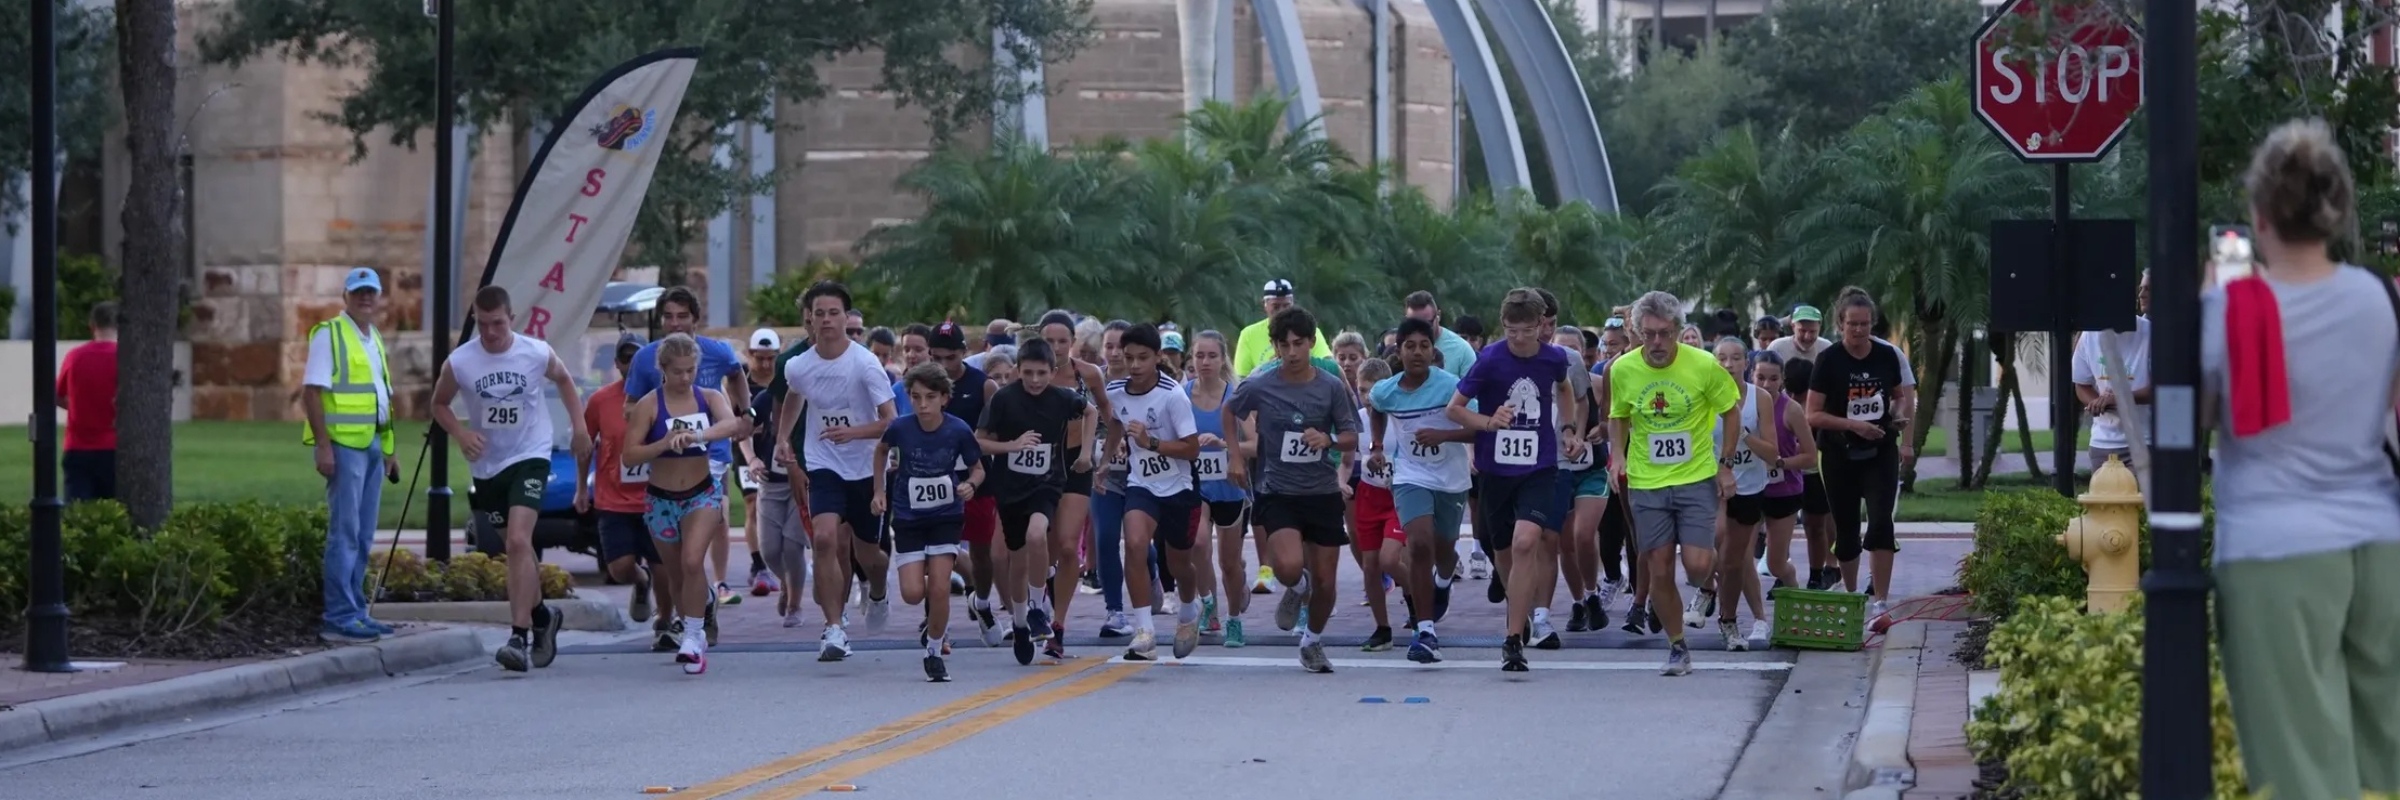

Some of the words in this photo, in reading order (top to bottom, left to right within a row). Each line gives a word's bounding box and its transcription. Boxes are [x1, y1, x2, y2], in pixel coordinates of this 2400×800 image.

[1990, 45, 2130, 104] STOP
[523, 167, 606, 339] STAR
[475, 371, 527, 393] HORNETS
[488, 406, 519, 424] 295
[1853, 401, 1879, 416] 336
[1501, 437, 1533, 458] 315
[1654, 438, 1686, 458] 283
[1014, 449, 1046, 468] 285
[1140, 455, 1171, 478] 268
[1195, 458, 1223, 475] 281
[914, 483, 948, 502] 290
